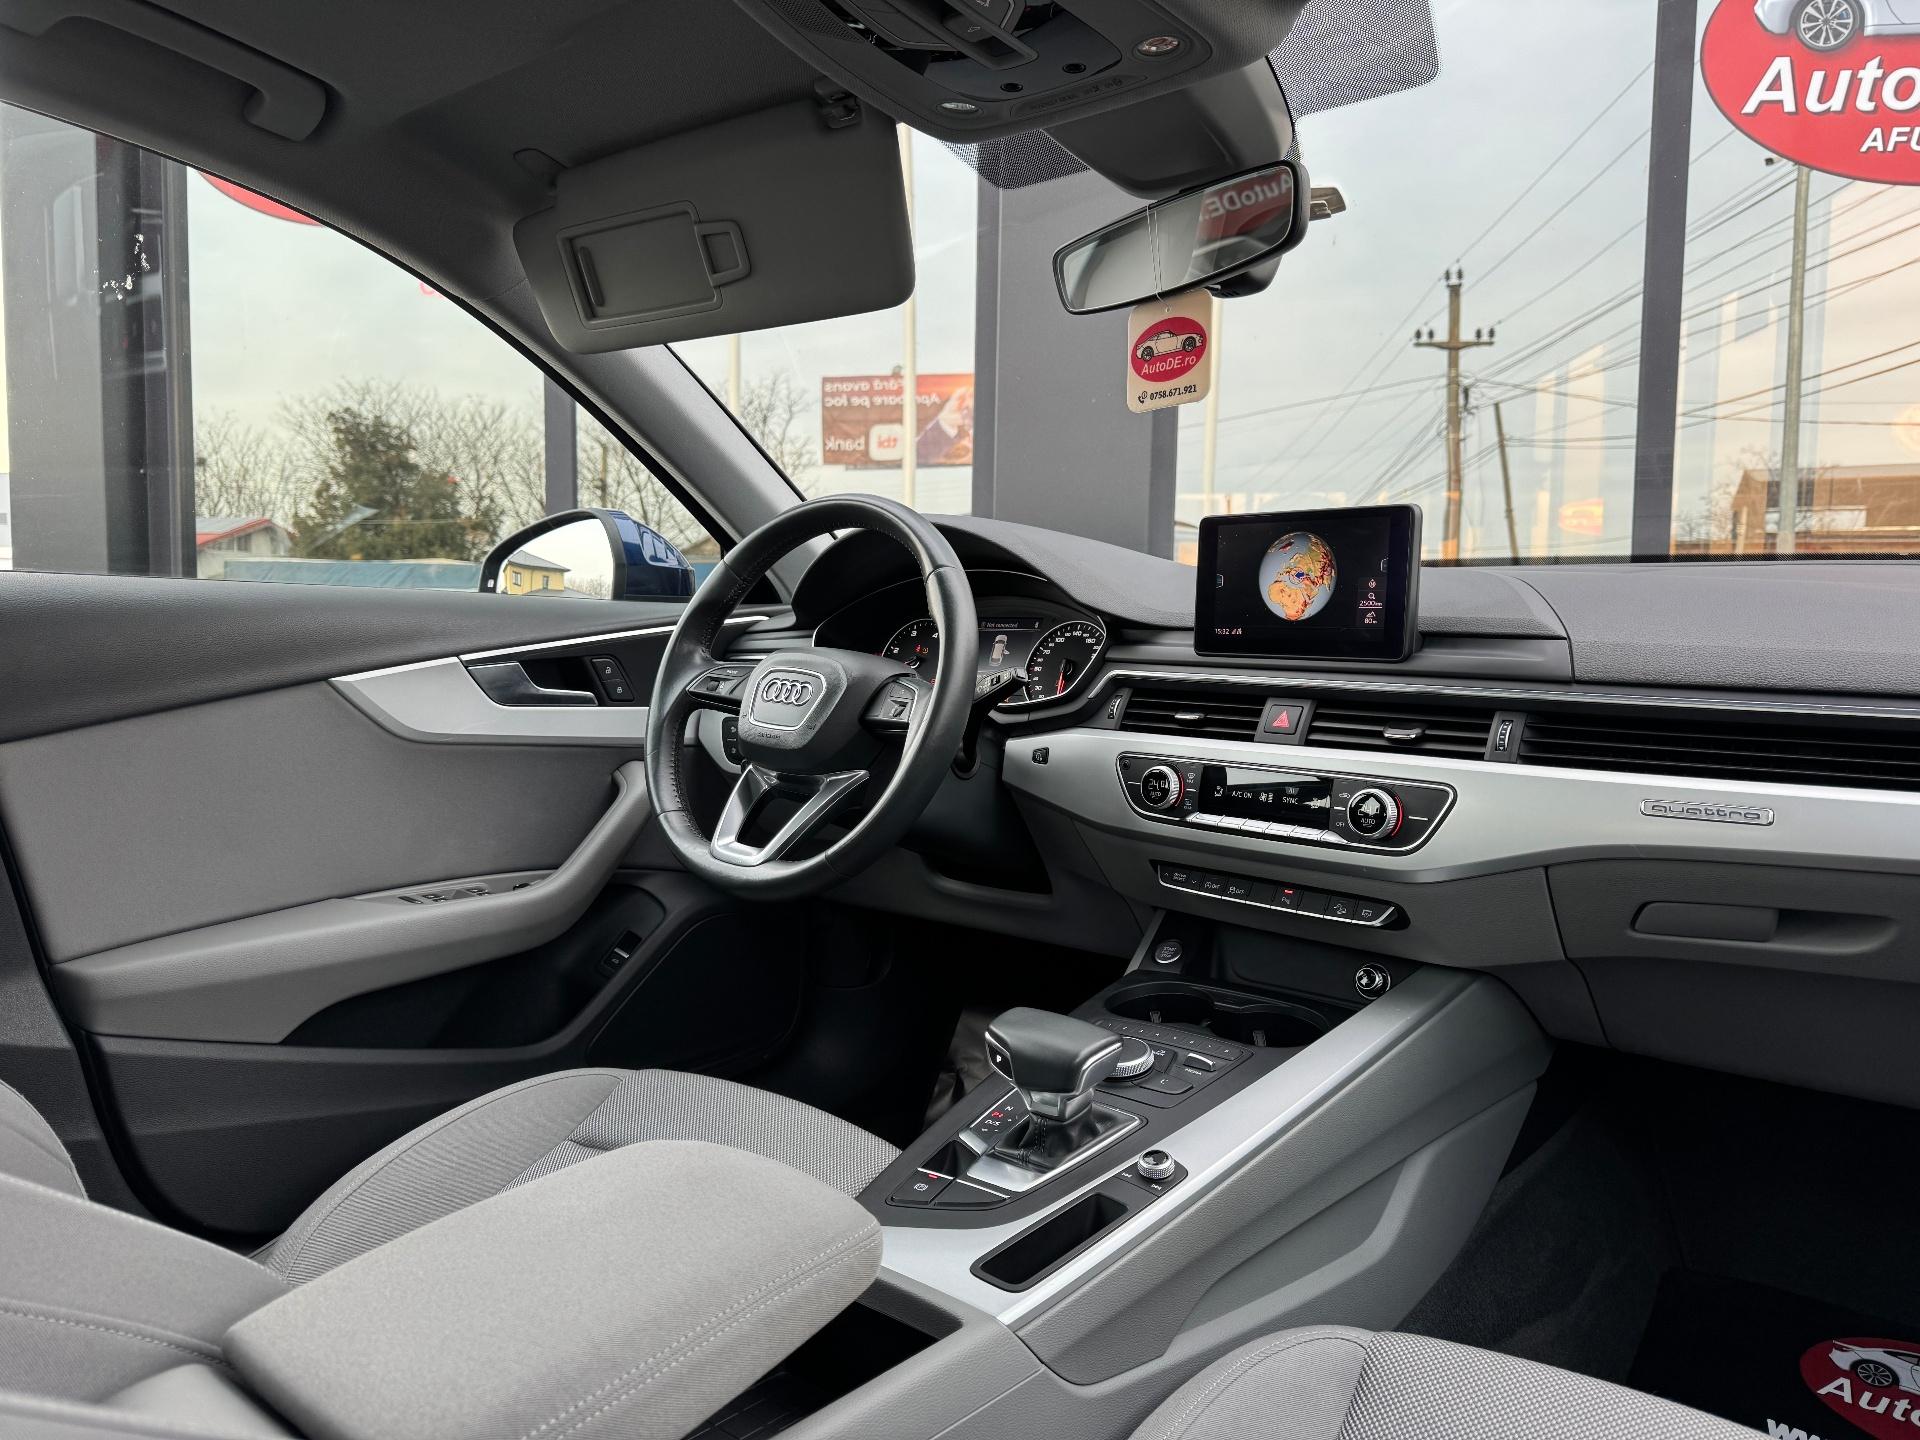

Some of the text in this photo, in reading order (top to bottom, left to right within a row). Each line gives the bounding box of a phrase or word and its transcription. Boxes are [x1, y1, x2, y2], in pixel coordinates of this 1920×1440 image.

[1741, 55, 1920, 114] Auto
[1141, 355, 1197, 376] AutoDE.ro
[1149, 384, 1198, 401] 0758.671.921
[1282, 796, 1299, 805] SYNC
[1651, 804, 1761, 820] quattro
[996, 1054, 1002, 1063] P
